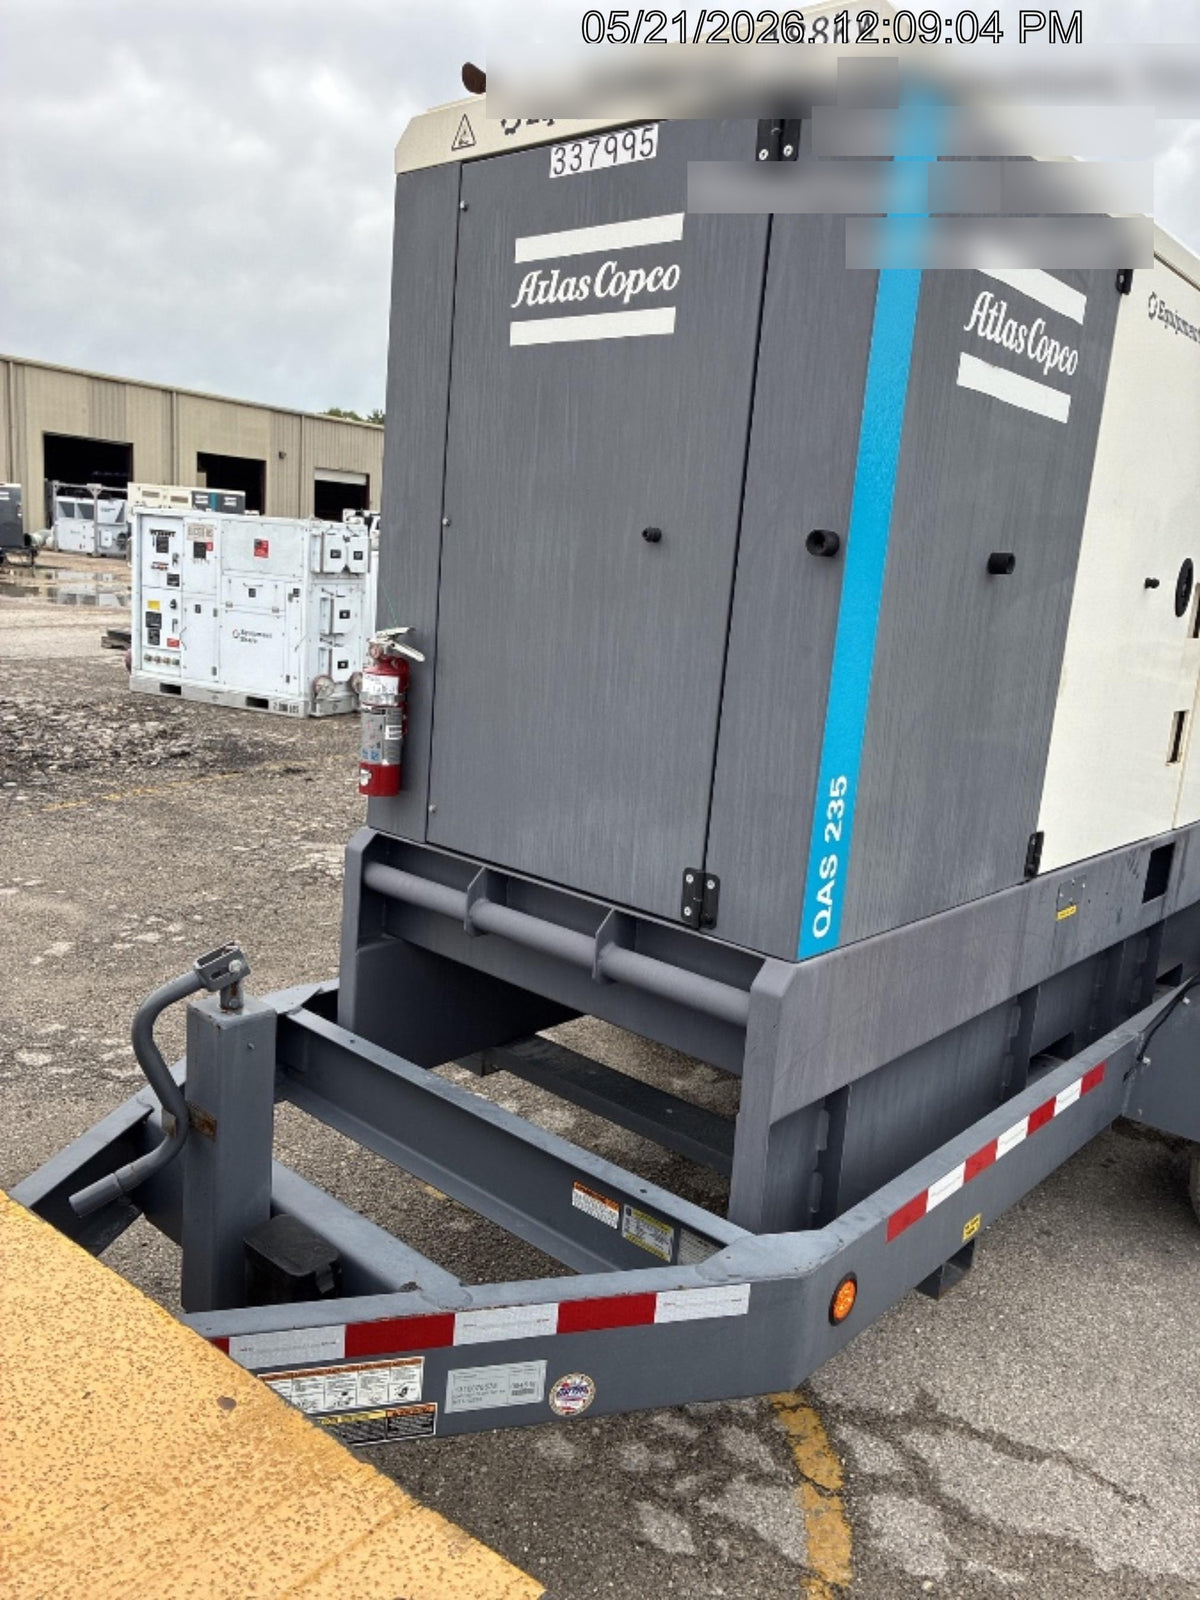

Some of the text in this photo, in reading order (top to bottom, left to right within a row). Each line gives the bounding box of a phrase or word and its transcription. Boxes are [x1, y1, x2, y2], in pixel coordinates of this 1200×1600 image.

[552, 126, 655, 176] 337995
[510, 260, 681, 309] Atlas Copco
[963, 290, 1079, 376] Atlas Copco
[812, 774, 848, 940] QAS 235
